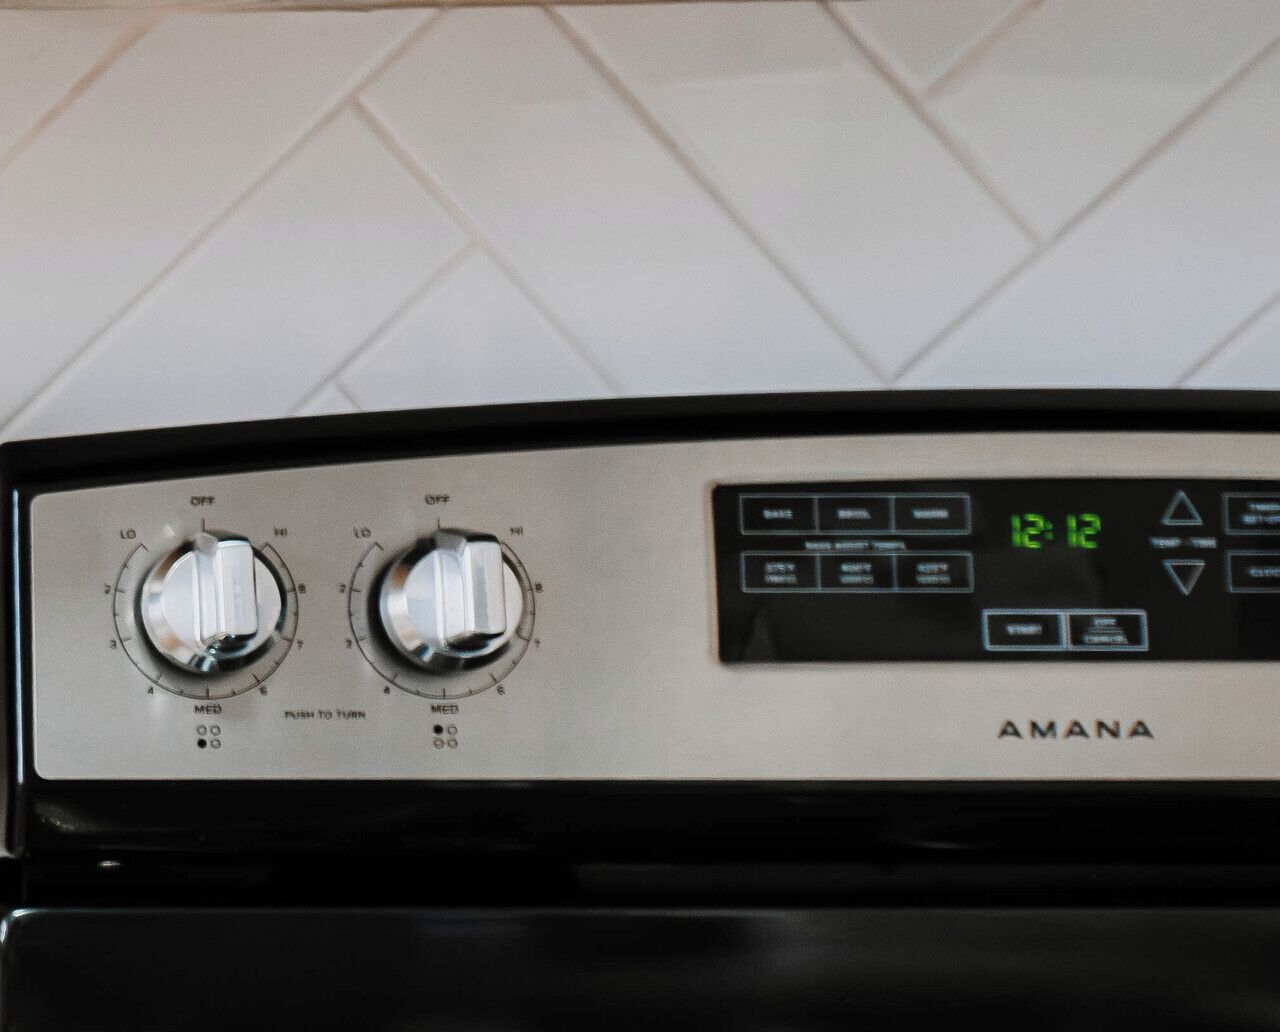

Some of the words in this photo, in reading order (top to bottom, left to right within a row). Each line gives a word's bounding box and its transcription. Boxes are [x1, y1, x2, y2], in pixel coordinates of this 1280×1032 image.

[1009, 512, 1103, 551] 12:12
[193, 704, 223, 716] MED
[284, 709, 315, 720] PUSH
[318, 709, 333, 720] TO
[336, 709, 367, 720] TURN
[430, 703, 459, 715] MED
[996, 718, 1155, 740] AMANA
